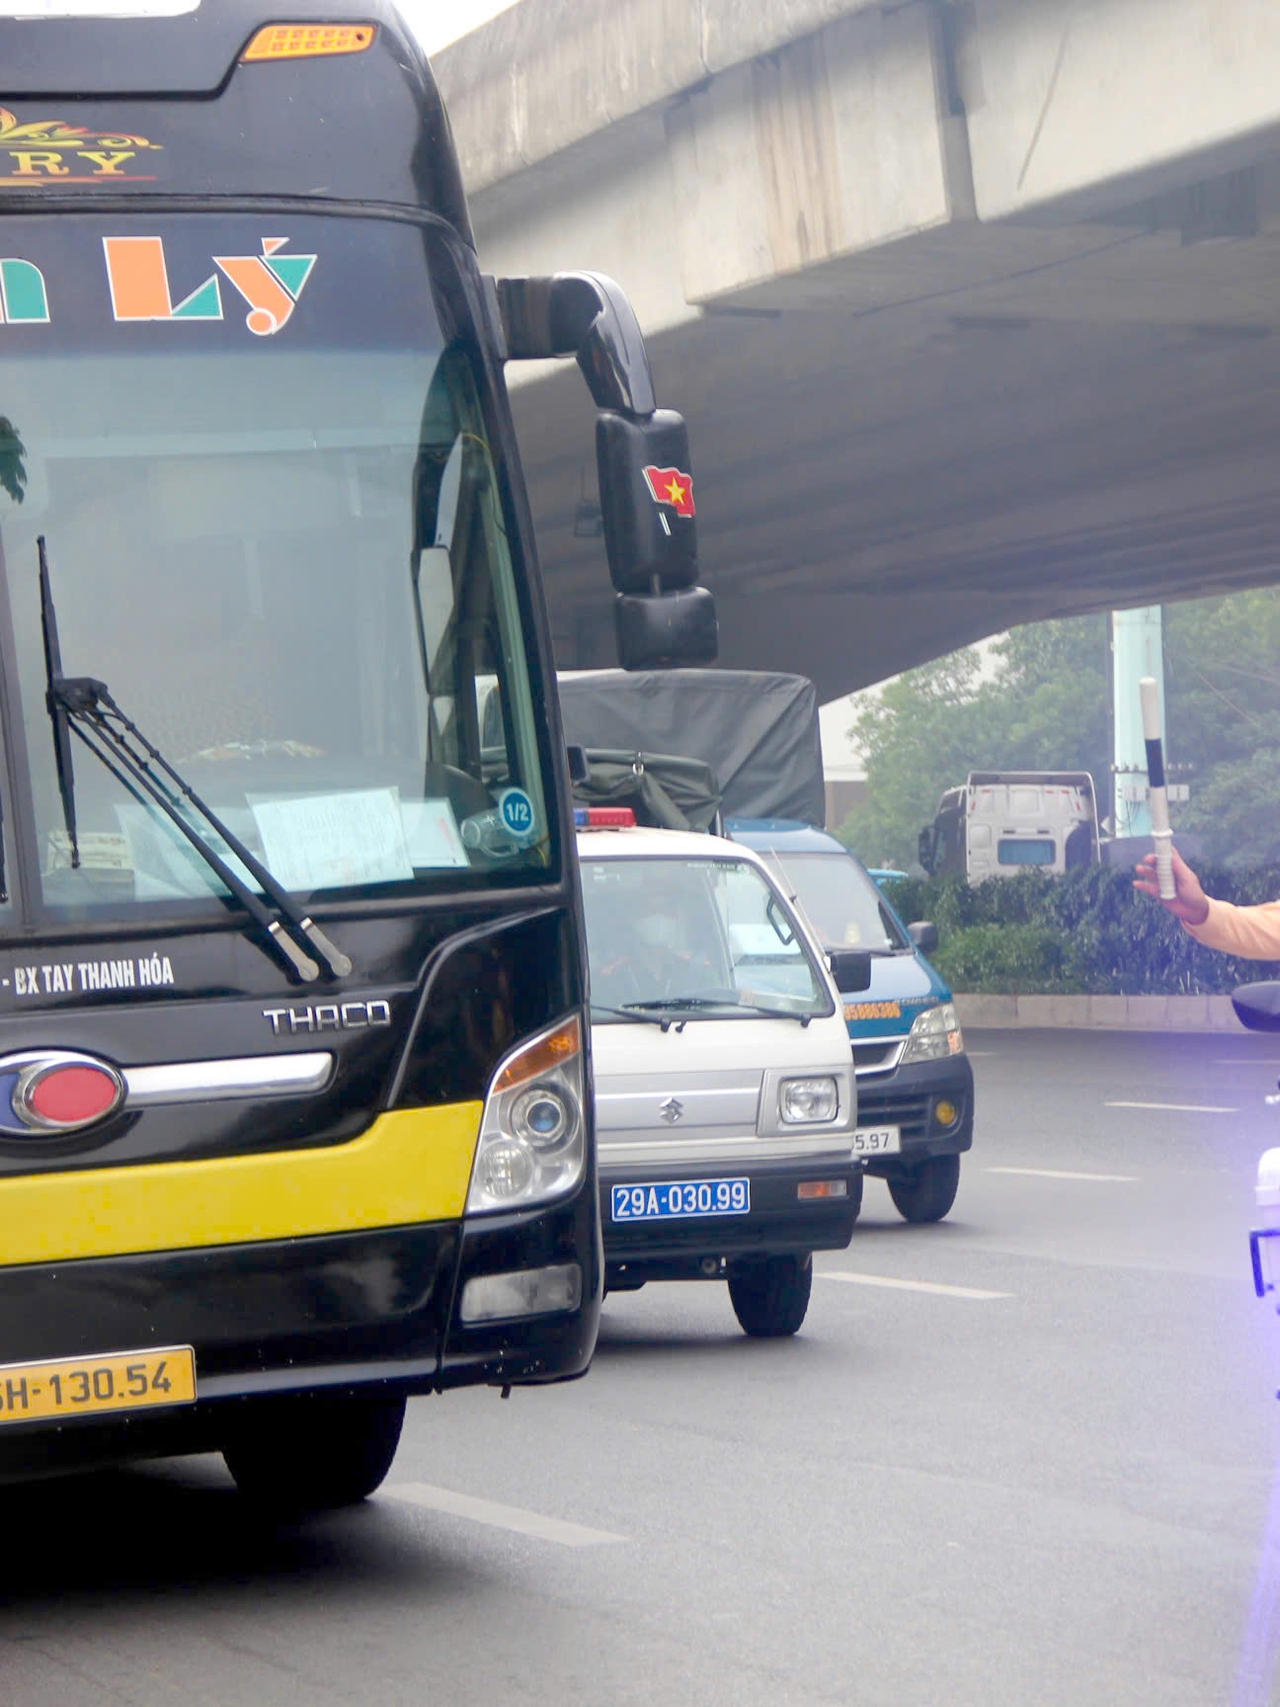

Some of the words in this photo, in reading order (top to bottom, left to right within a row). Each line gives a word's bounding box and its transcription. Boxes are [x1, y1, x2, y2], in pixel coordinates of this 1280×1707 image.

[9, 151, 135, 175] RY
[102, 236, 318, 336] Lý
[506, 803, 529, 822] 1/2
[14, 966, 39, 995] BX
[42, 963, 73, 992] TAY
[77, 959, 135, 990] THANH
[138, 952, 174, 986] HÓA
[262, 1000, 391, 1036] THACO
[616, 1182, 746, 1217] 29A-030.99
